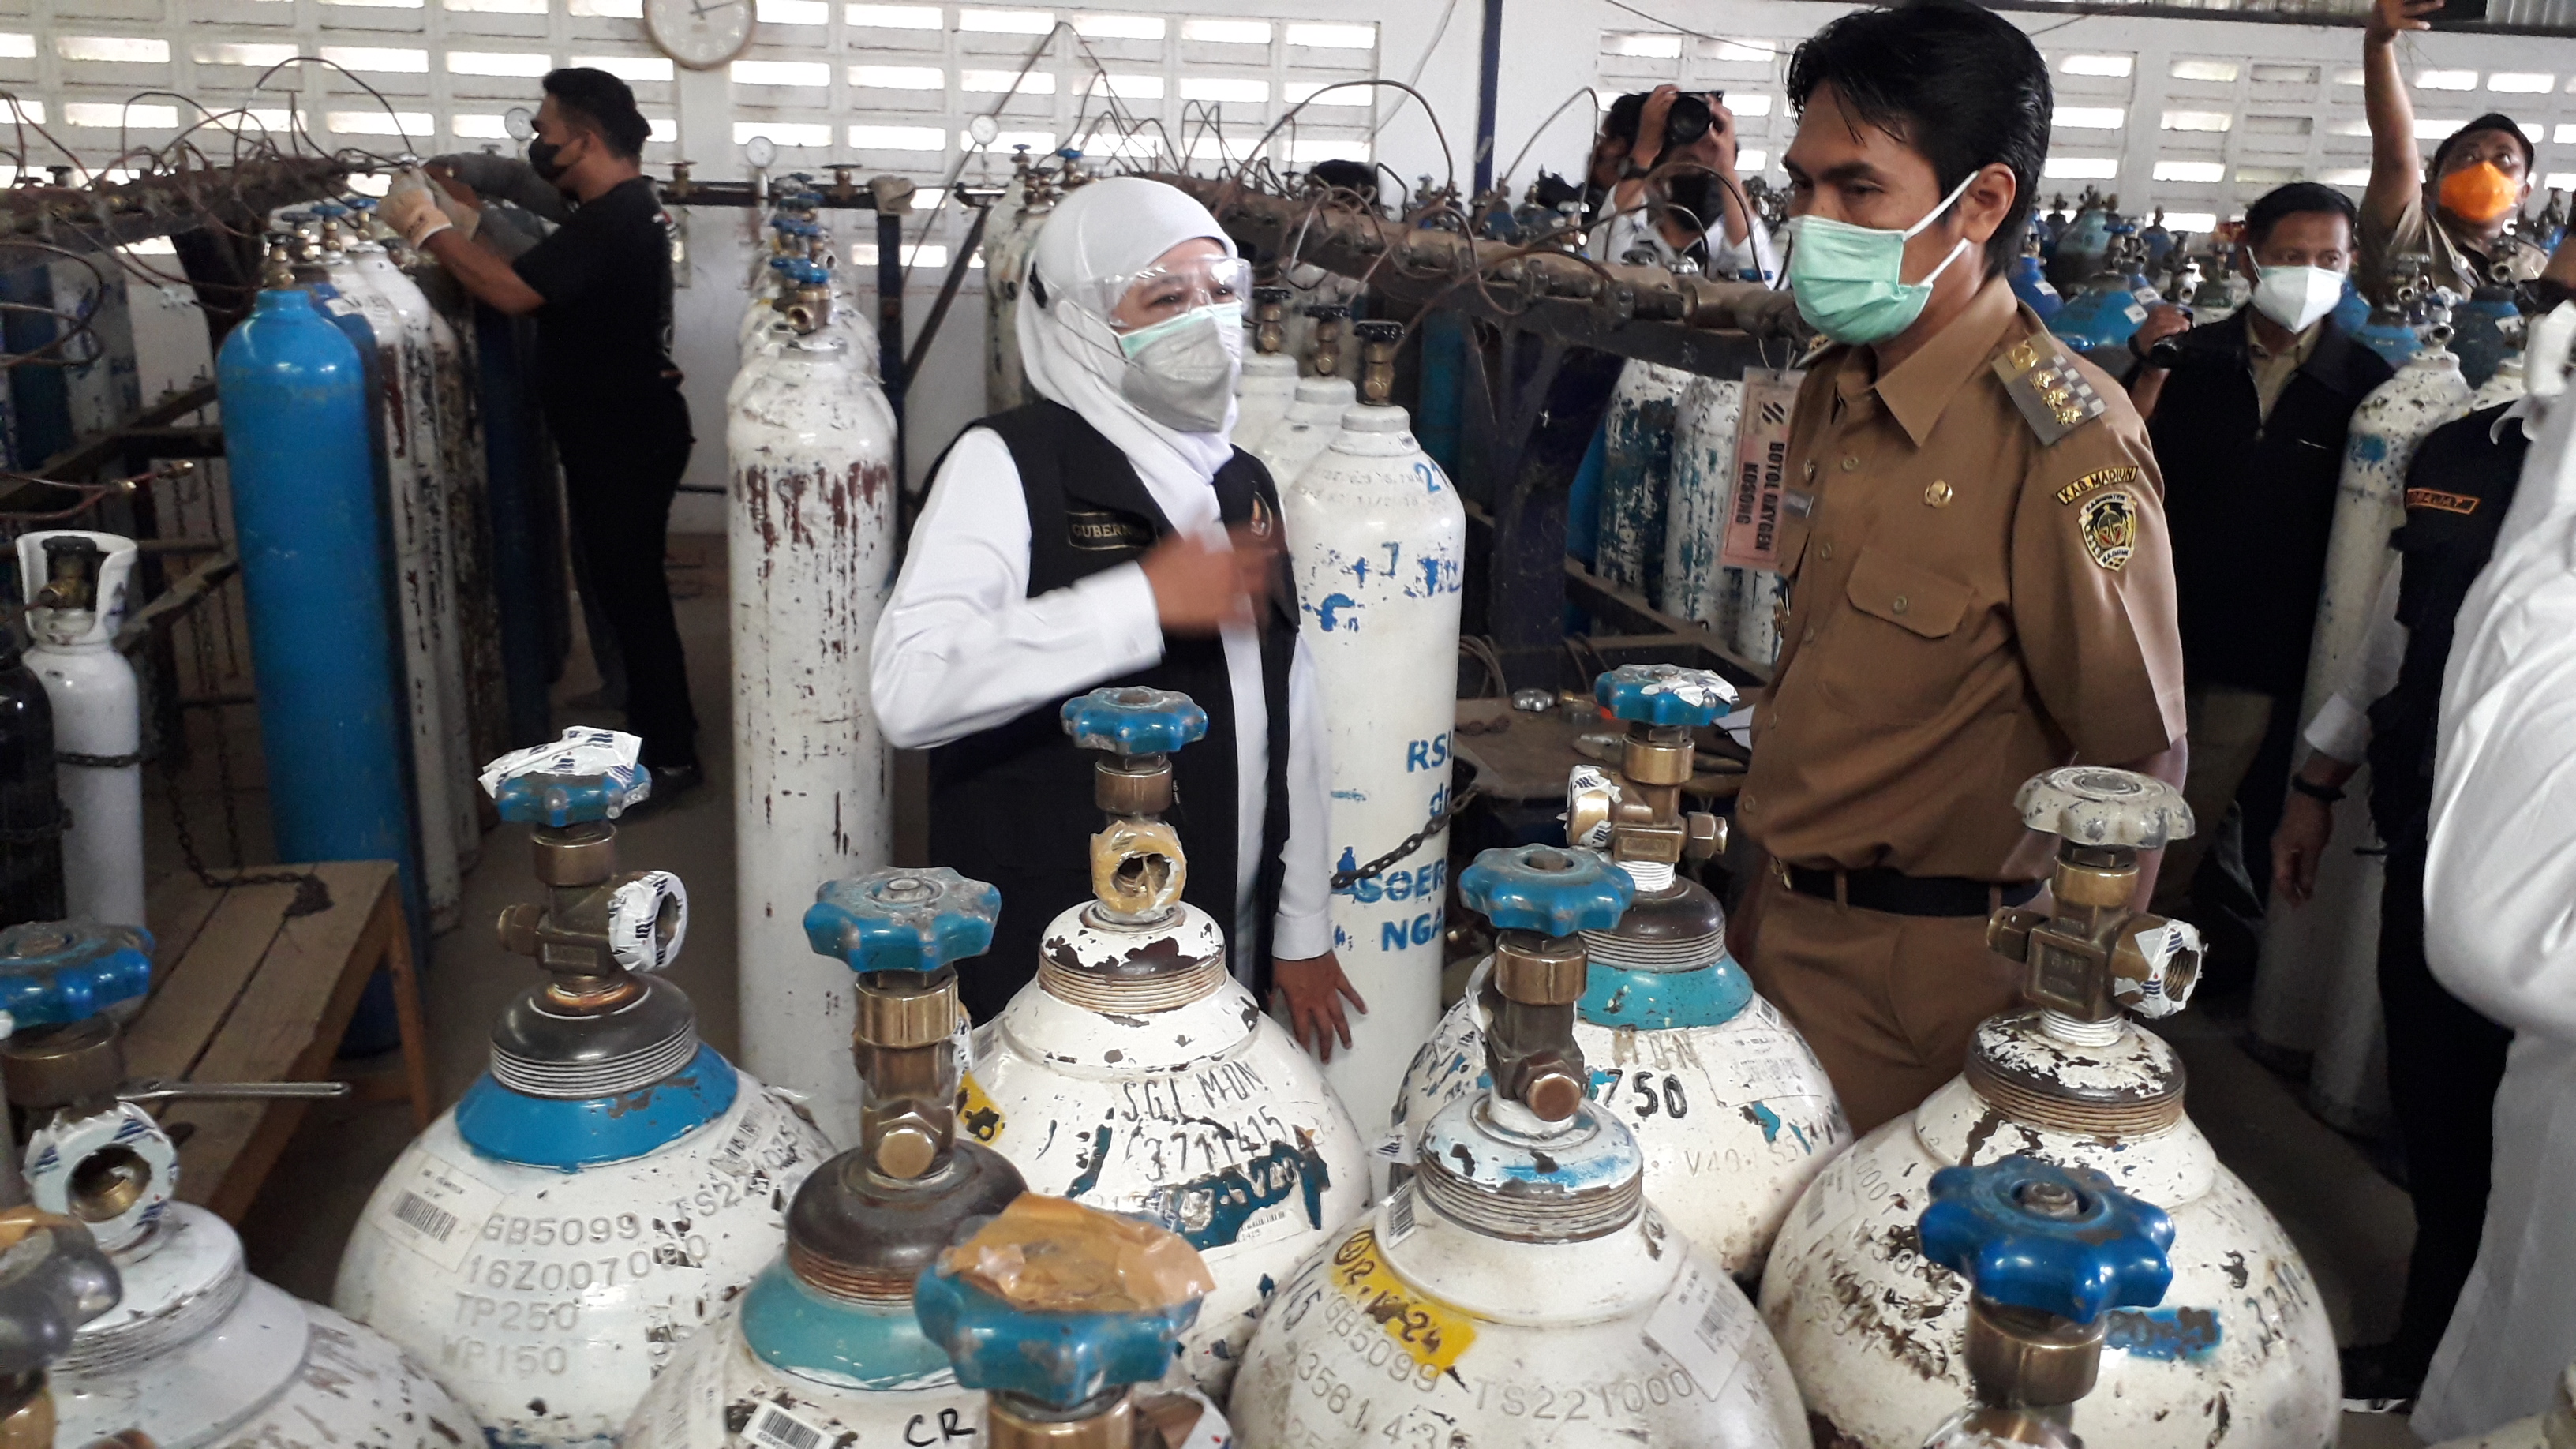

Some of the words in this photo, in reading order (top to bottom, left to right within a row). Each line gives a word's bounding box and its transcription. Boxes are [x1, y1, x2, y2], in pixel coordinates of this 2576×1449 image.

[481, 1211, 641, 1247] GB5099
[455, 1290, 578, 1332] TP250
[1324, 1295, 1440, 1392] GB5099
[904, 1407, 977, 1447] CR
